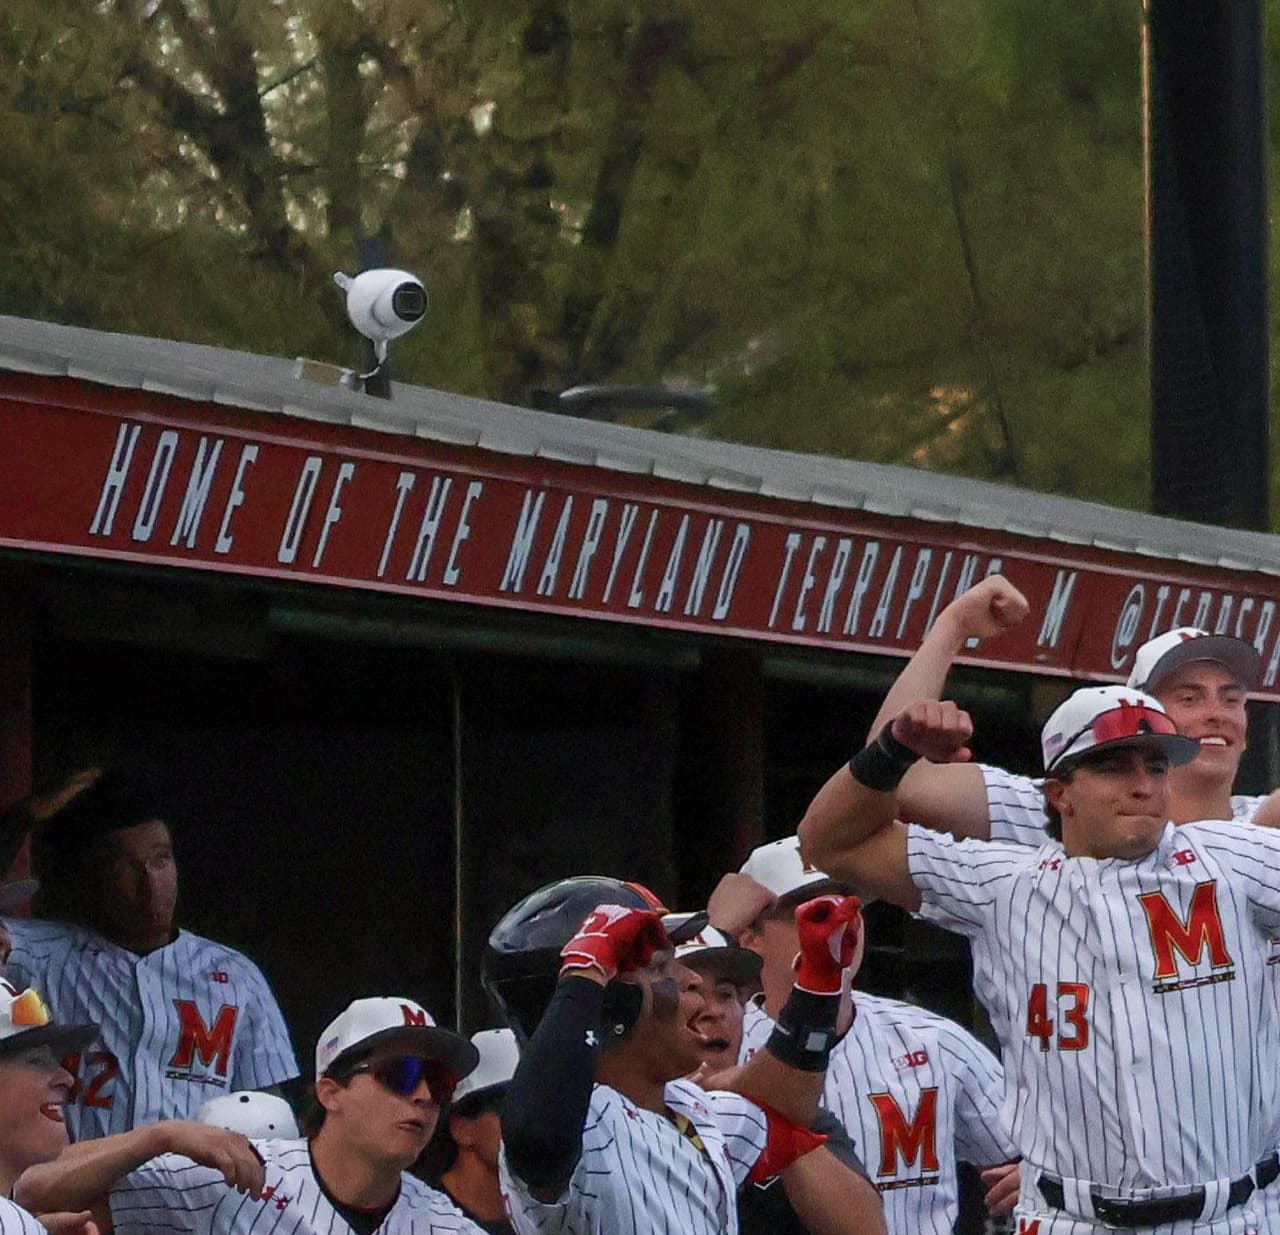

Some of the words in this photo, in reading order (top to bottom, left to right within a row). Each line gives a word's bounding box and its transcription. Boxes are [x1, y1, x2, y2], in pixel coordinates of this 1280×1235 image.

[89, 422, 259, 554] HOME
[277, 456, 355, 568] OF
[377, 472, 483, 586] THE
[499, 488, 751, 621] MARYLAND
[1037, 570, 1077, 648] M
[1137, 879, 1235, 980] M
[168, 999, 239, 1077] M
[1025, 982, 1090, 1052] 43
[868, 1086, 940, 1178] M
